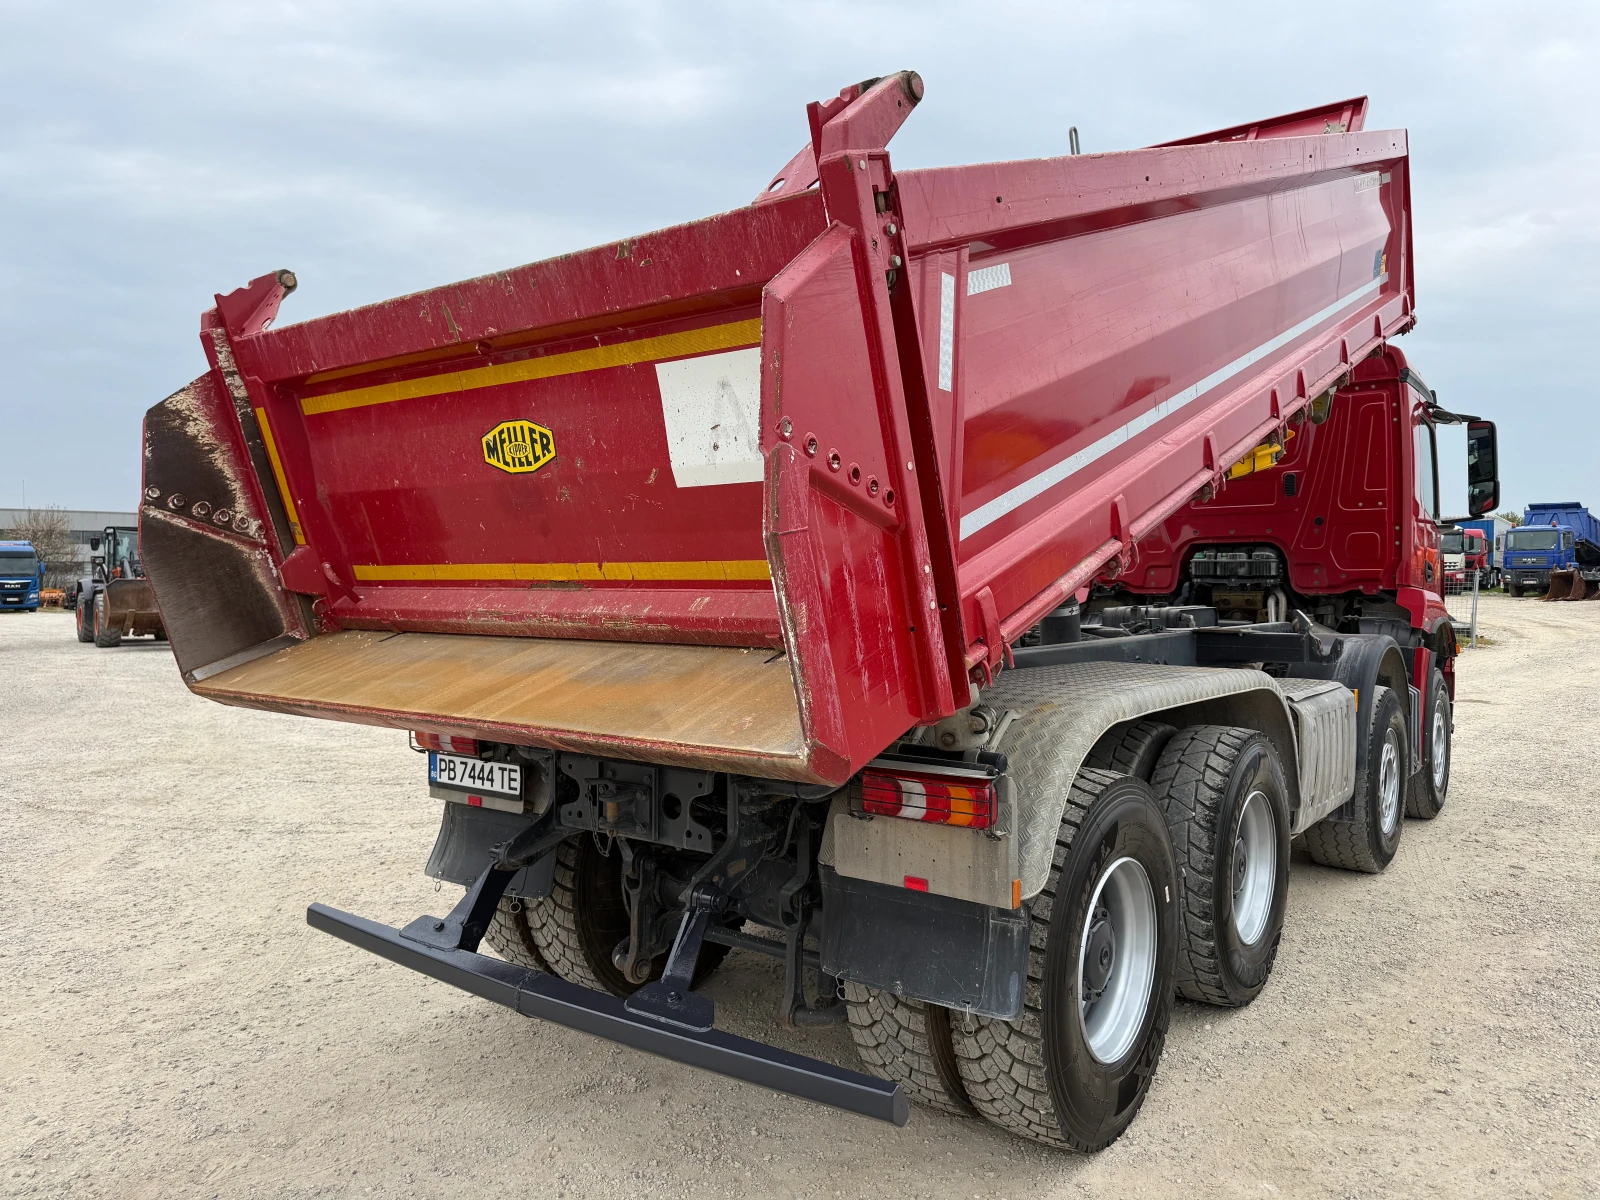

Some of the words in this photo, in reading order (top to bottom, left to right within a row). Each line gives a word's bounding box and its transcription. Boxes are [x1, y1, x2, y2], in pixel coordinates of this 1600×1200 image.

[485, 425, 552, 468] MEILLER
[438, 758, 457, 781] PB
[459, 761, 495, 788] 7444
[498, 766, 518, 792] TE
